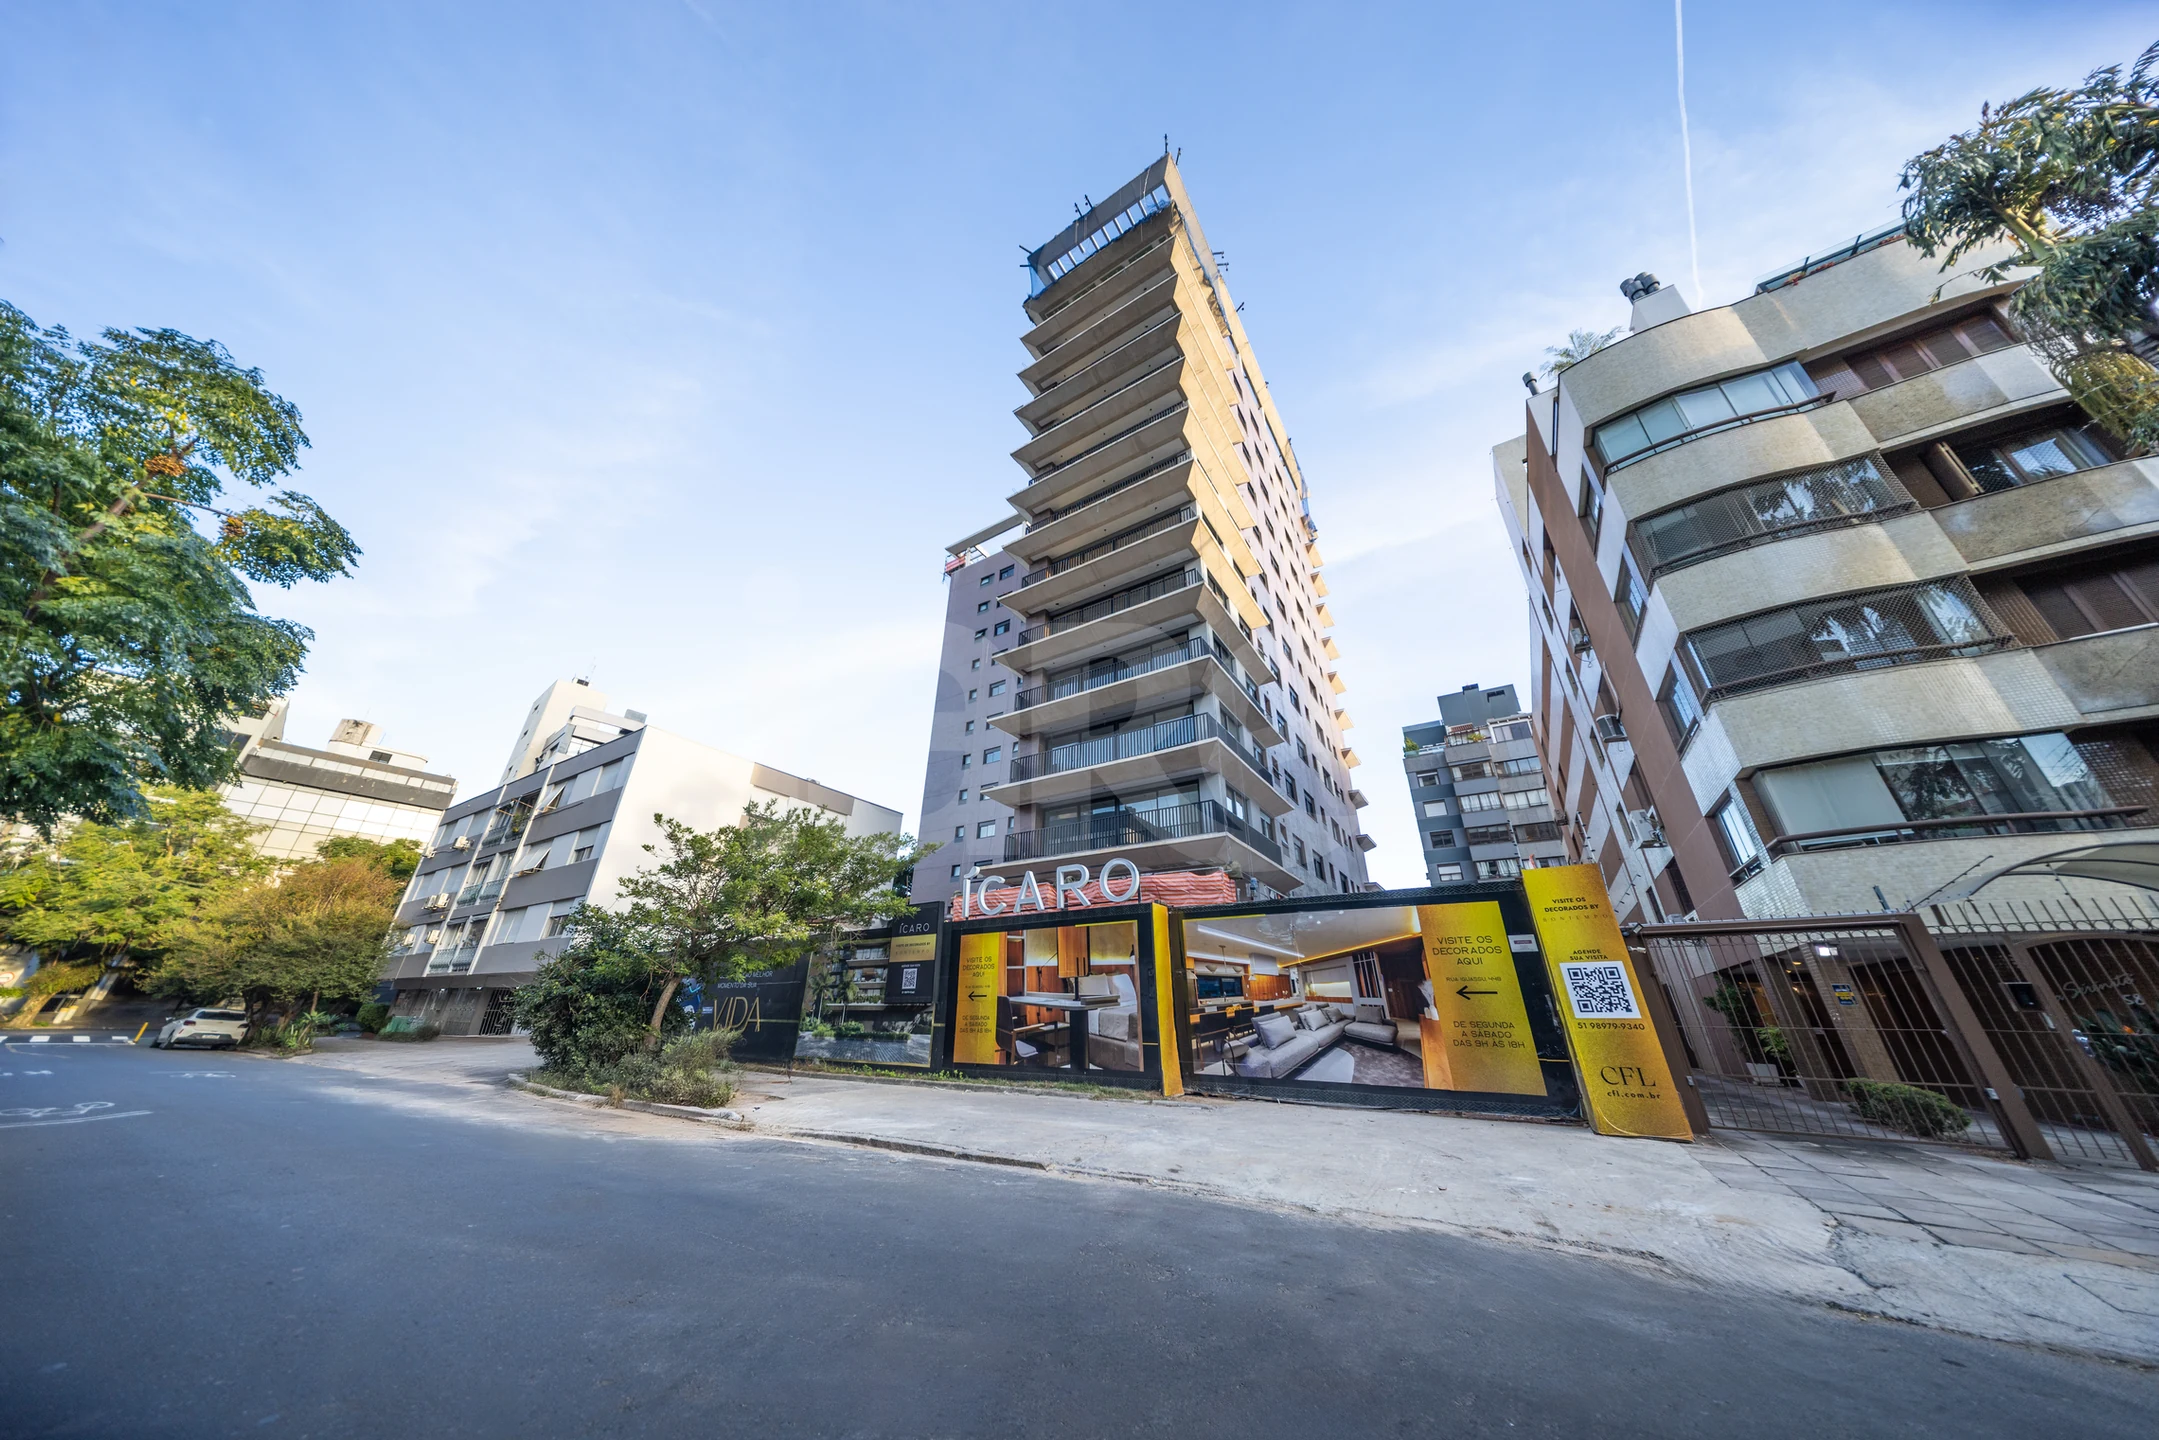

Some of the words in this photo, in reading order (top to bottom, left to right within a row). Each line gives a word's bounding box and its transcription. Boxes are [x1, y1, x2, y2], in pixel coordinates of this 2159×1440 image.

[962, 857, 1140, 918] ÍCARO
[1436, 936, 1472, 944] VISITE
[1476, 935, 1493, 943] OS
[1432, 946, 1502, 955] DECORADOS
[1456, 957, 1483, 965] AQUI
[2122, 993, 2146, 1006] 58
[713, 996, 760, 1033] VIDA
[1453, 1020, 1467, 1028] DE
[1589, 1022, 1645, 1030] 98979-9340
[1453, 1039, 1472, 1047] DAS
[1600, 1065, 1657, 1087] CFL
[1607, 1089, 1661, 1099] cfl.com.br
